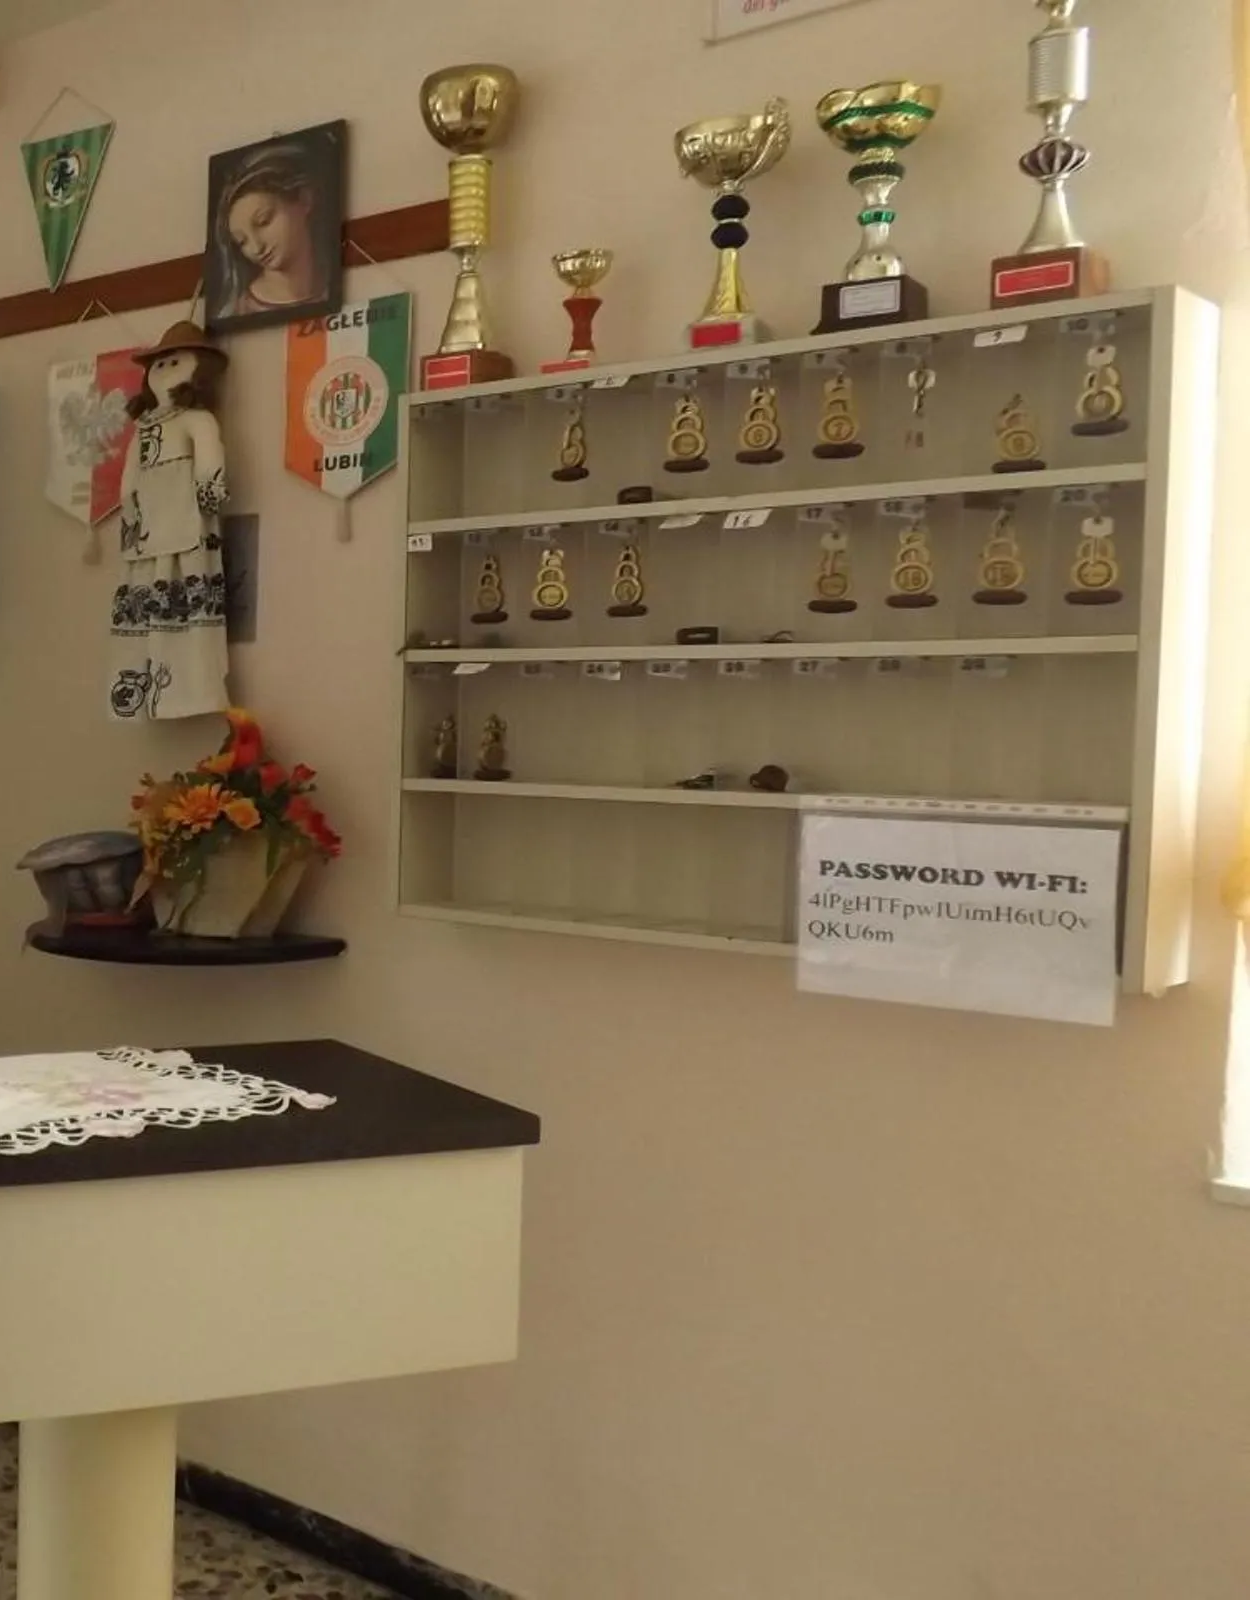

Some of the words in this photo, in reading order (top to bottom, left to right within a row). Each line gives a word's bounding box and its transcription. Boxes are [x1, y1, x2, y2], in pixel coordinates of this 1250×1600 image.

[818, 859, 985, 887] PASSWORD
[993, 870, 1088, 894] WI-FI:
[807, 919, 895, 944] QKU6m
